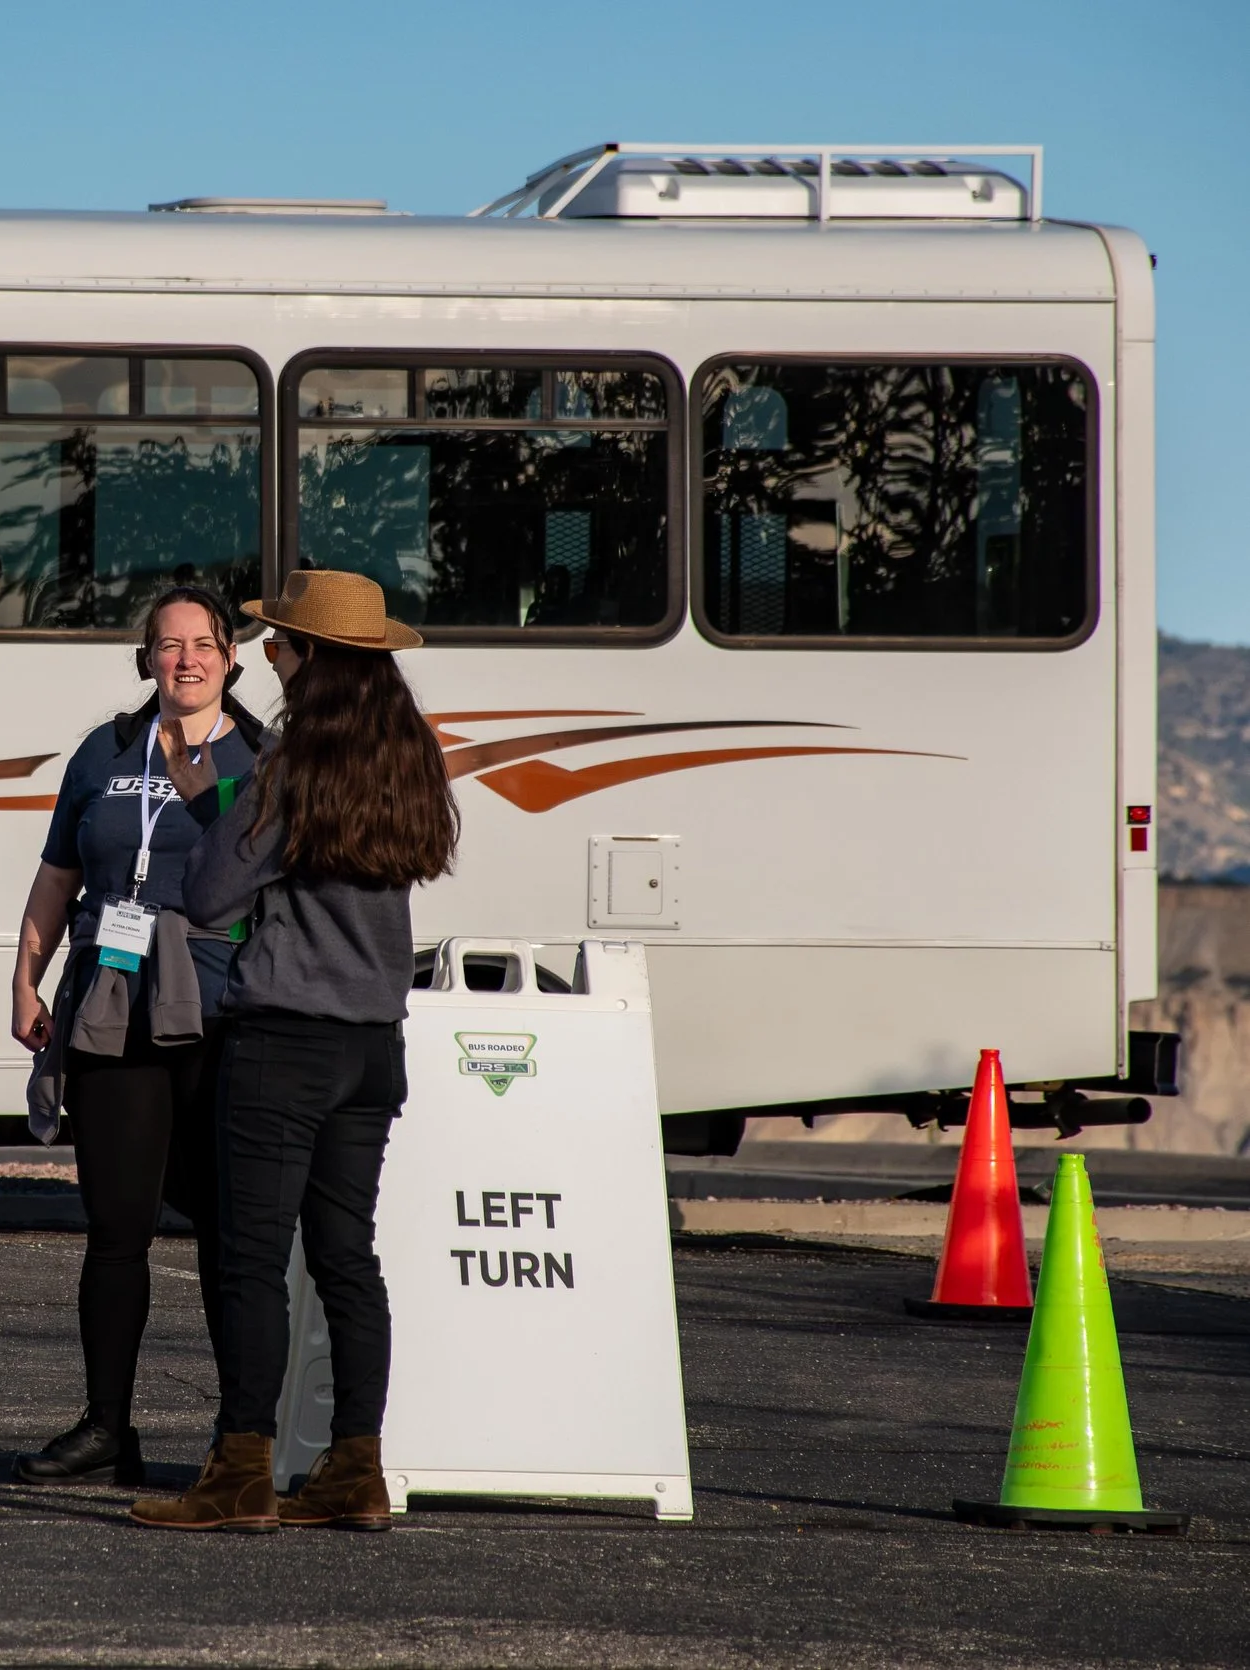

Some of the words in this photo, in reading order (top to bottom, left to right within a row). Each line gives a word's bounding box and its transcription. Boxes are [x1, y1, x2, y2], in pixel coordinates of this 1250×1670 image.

[468, 1043, 486, 1051] BUS
[487, 1044, 525, 1052] ROADEO
[468, 1062, 526, 1072] URSTA
[455, 1190, 562, 1229] LEFT
[450, 1249, 575, 1289] TURN
